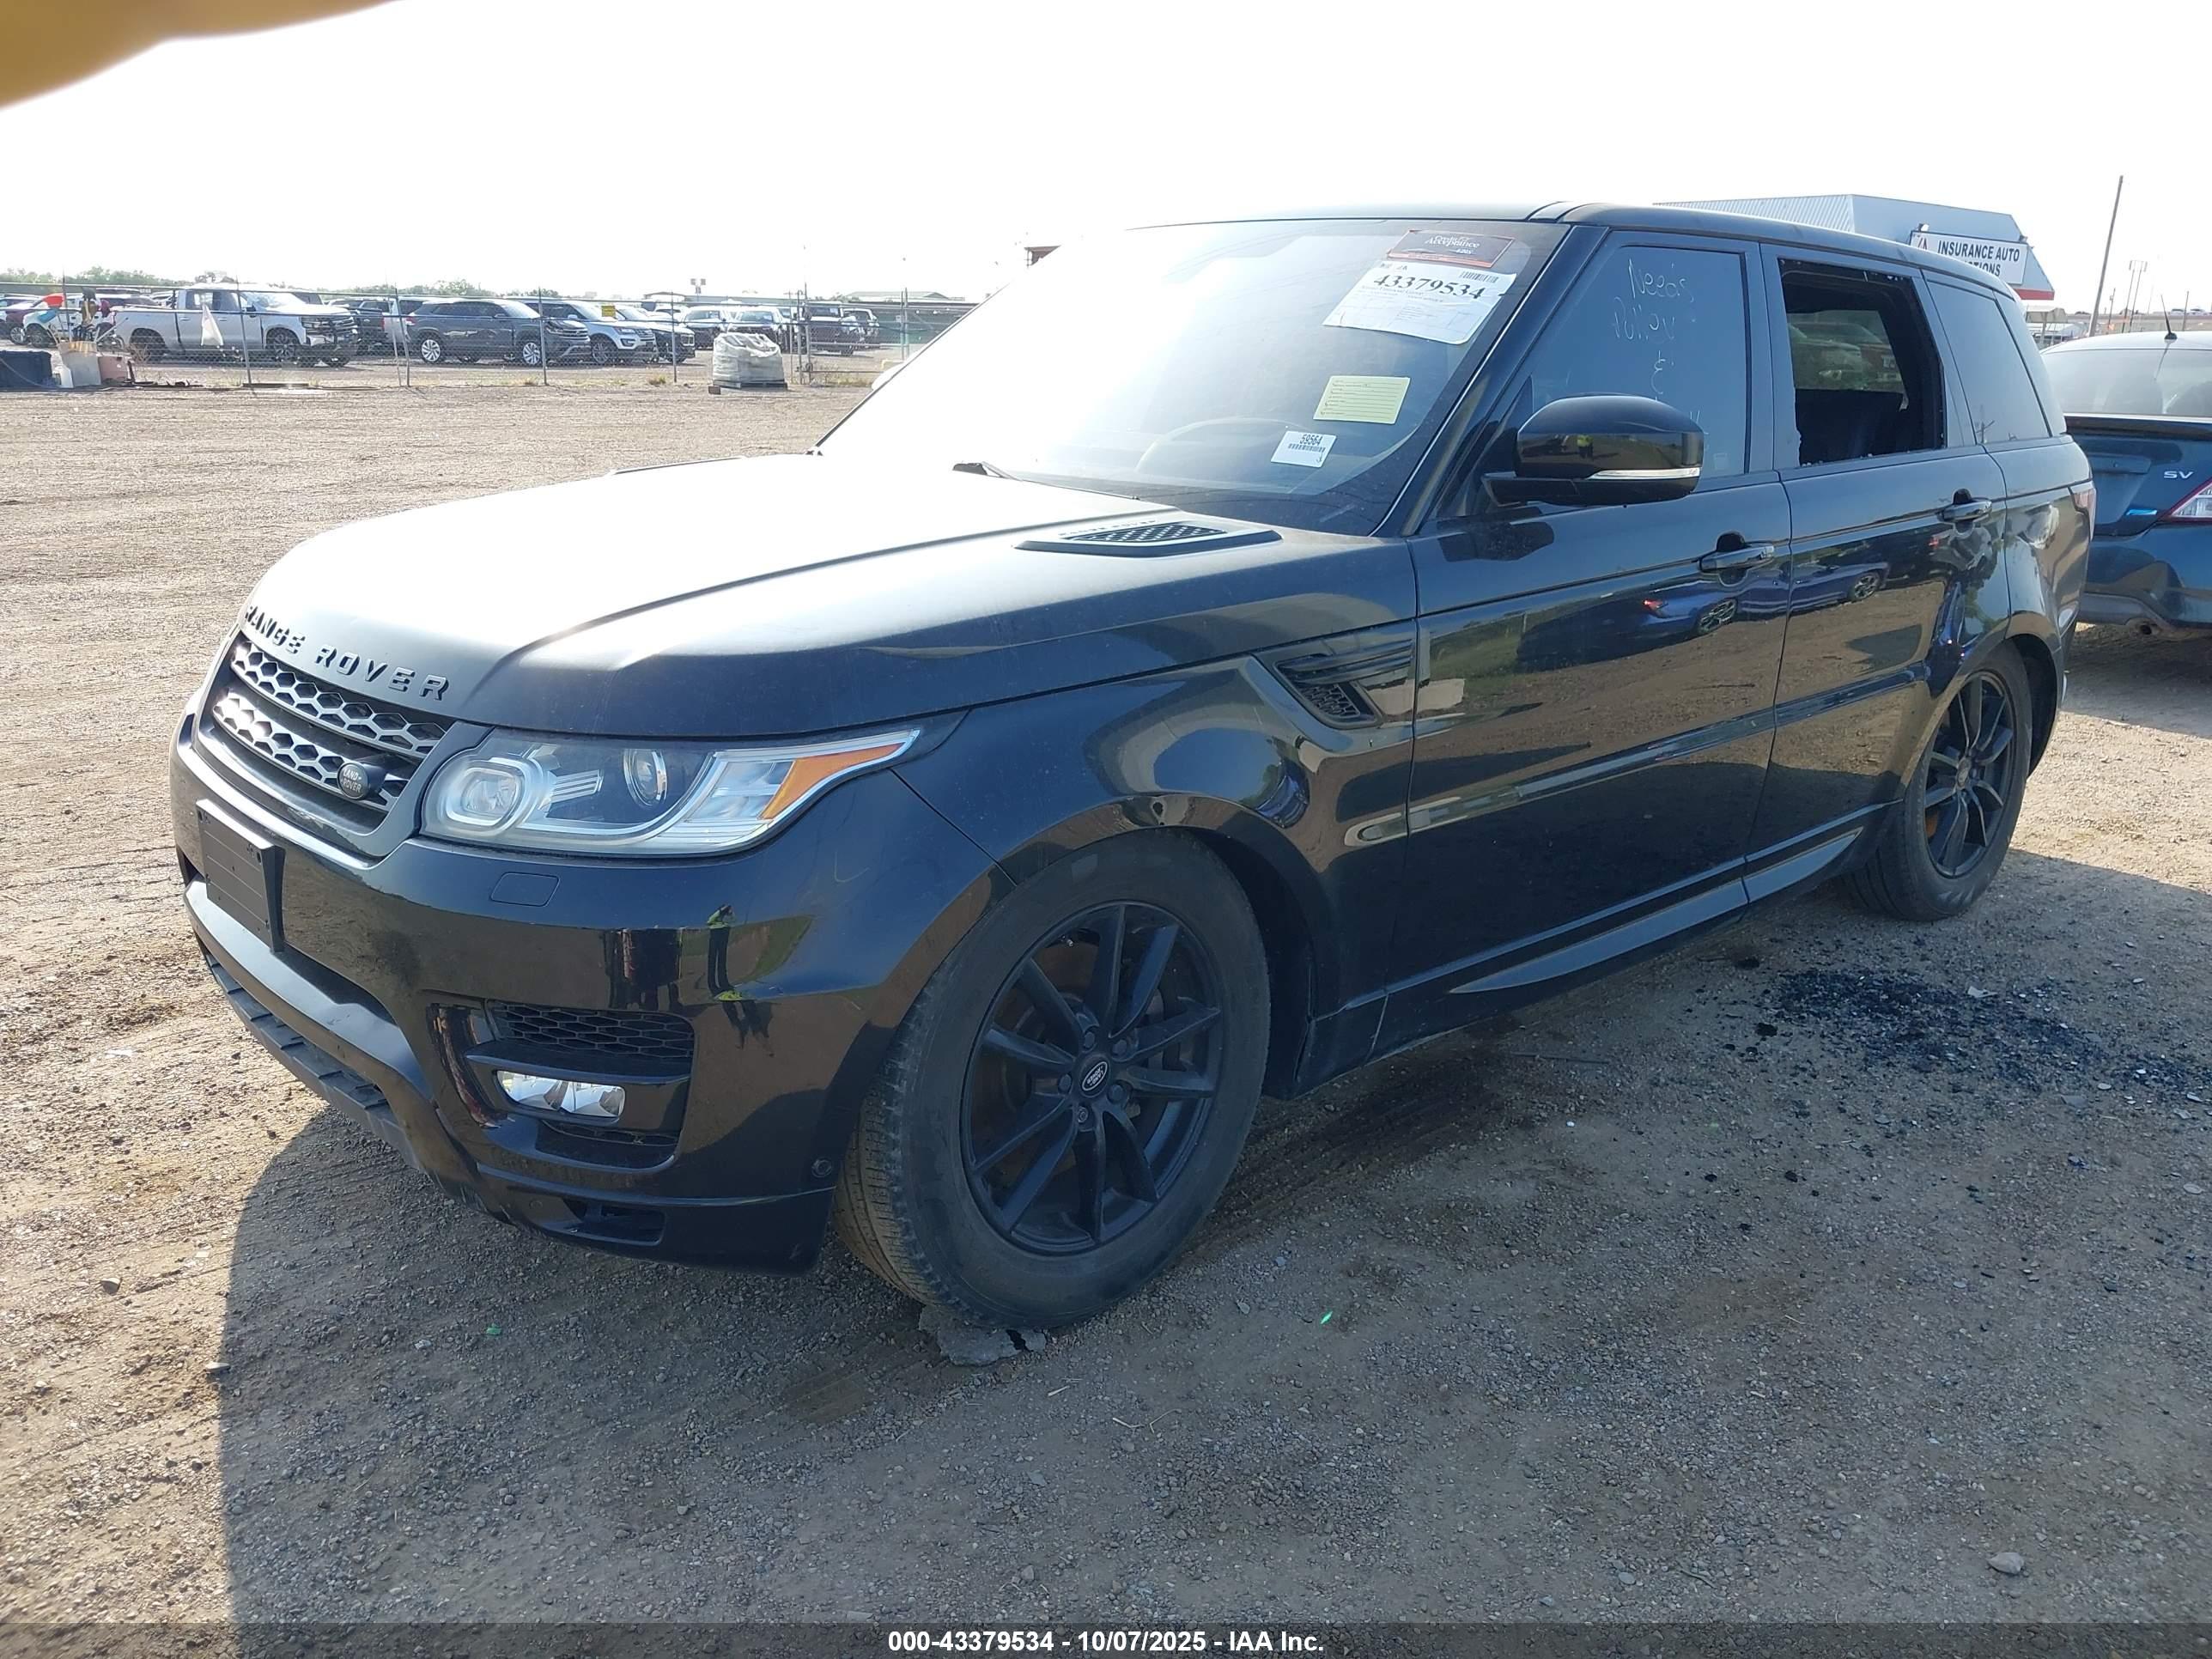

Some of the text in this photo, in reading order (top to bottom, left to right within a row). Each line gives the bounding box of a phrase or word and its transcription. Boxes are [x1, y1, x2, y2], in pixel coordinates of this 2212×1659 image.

[1937, 240, 1995, 259] INSURANCE
[1996, 246, 2021, 262] AUTO
[1373, 274, 1486, 300] 43379534
[1299, 434, 1323, 446] 59564
[2163, 471, 2194, 479] SV
[244, 605, 450, 702] RANGE ROVER
